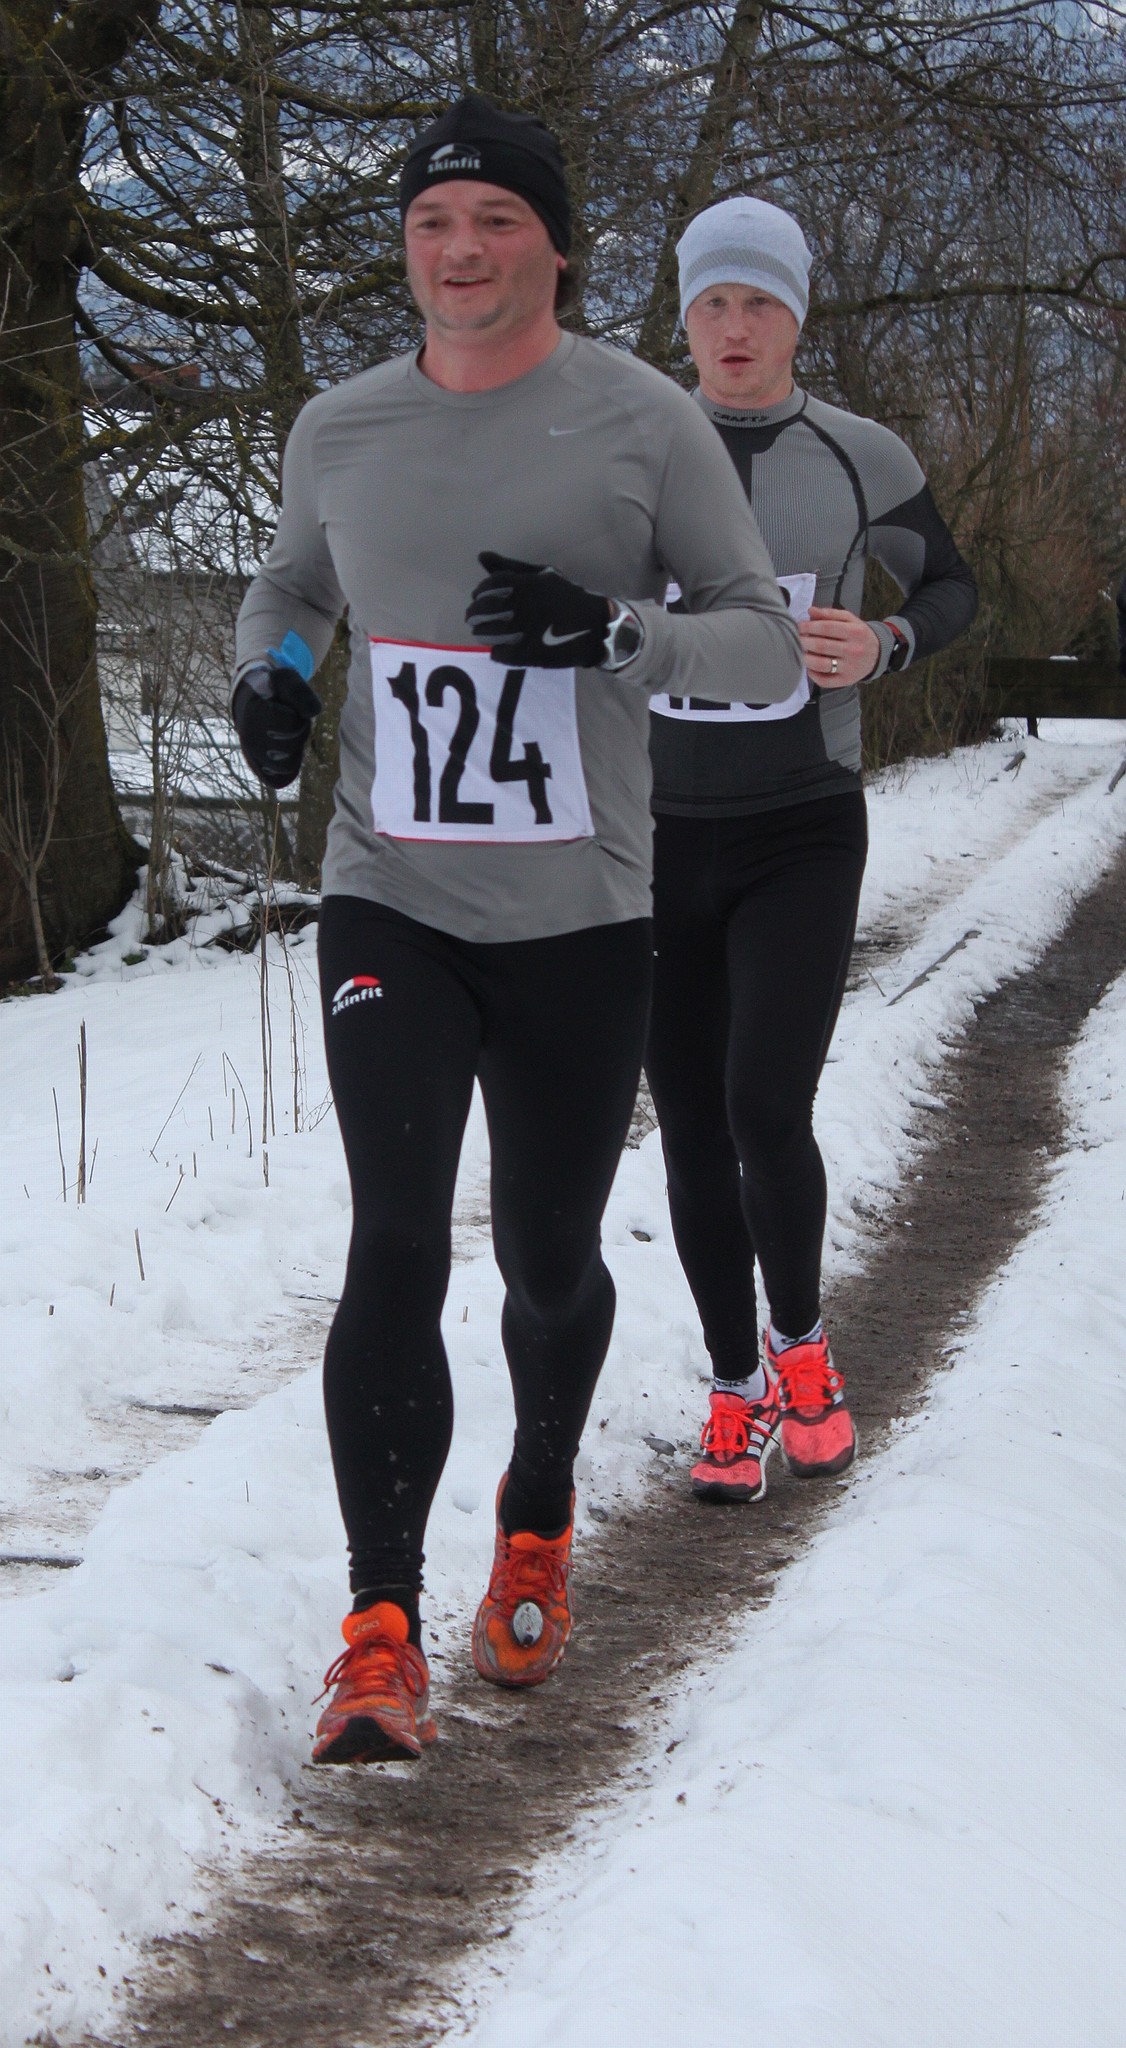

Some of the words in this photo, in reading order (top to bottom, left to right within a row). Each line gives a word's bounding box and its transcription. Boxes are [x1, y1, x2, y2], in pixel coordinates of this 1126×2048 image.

[427, 156, 481, 174] skinfit
[713, 411, 759, 422] CRAFT
[386, 661, 553, 825] 124
[331, 986, 383, 1016] skinfit
